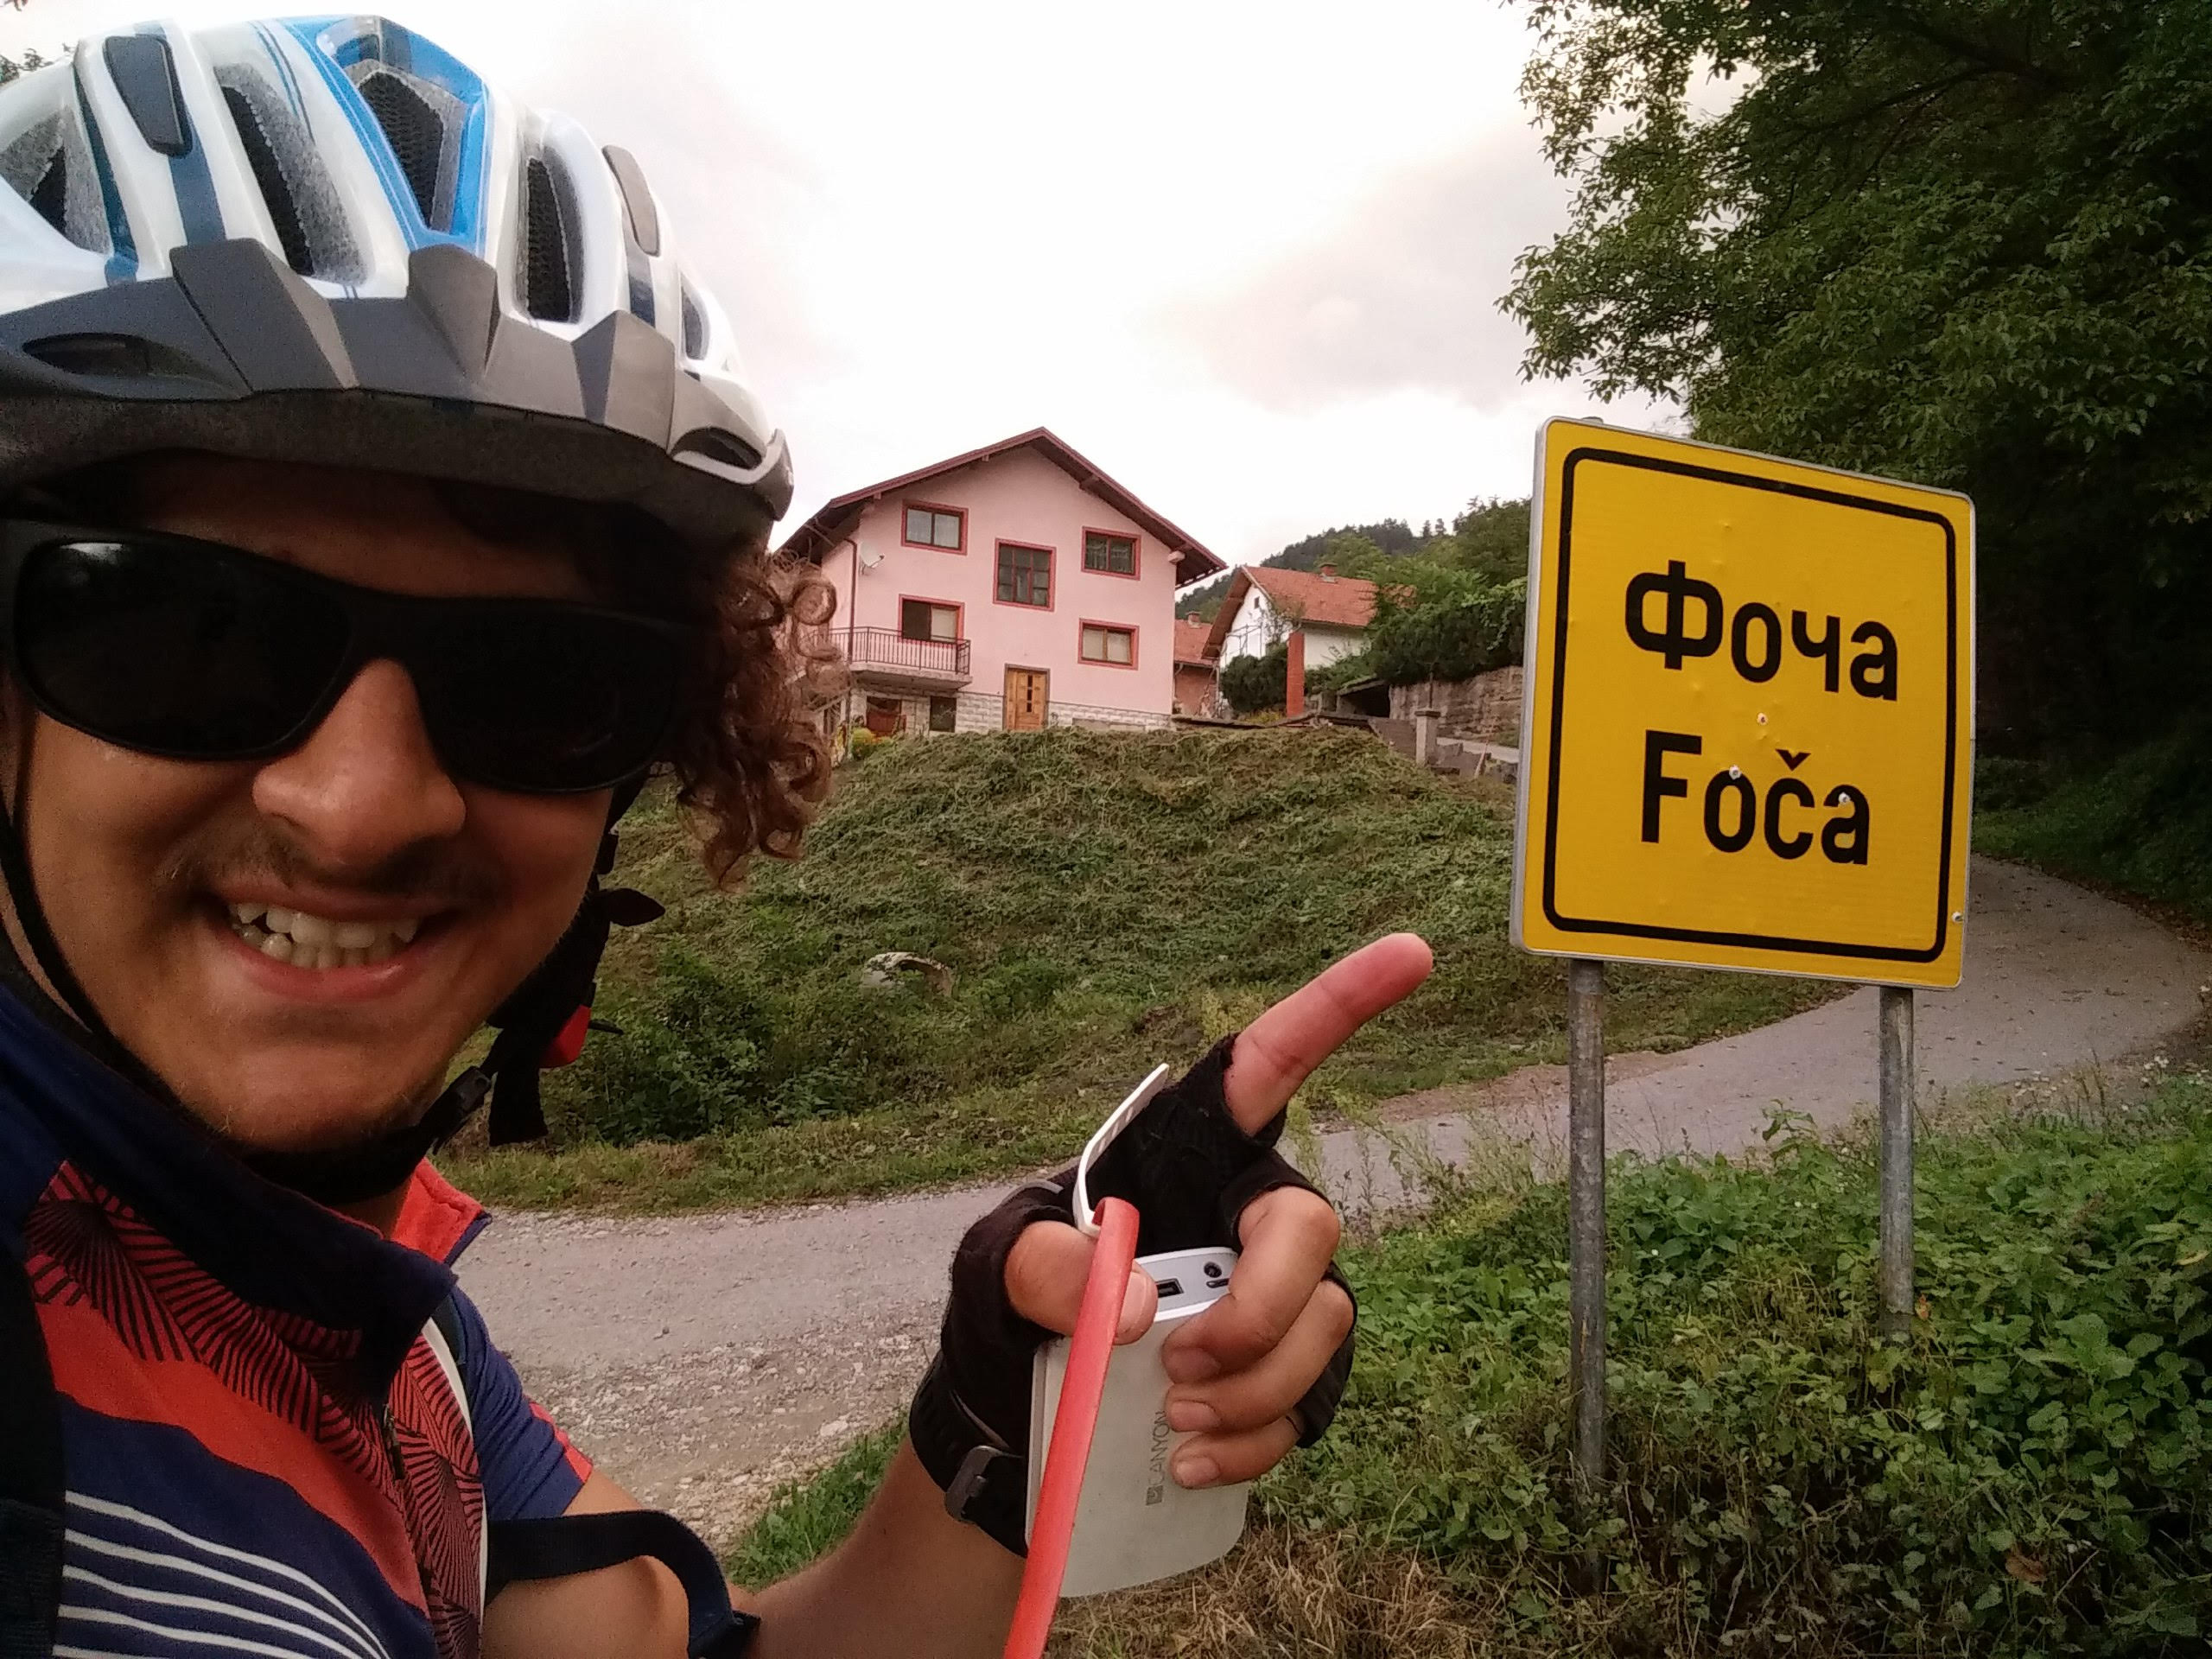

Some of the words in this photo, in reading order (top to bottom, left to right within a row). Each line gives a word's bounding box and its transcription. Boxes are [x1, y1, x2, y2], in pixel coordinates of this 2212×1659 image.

[1624, 560, 1897, 702] Фоча
[1642, 729, 1870, 866] Foča
[1147, 1410, 1170, 1486] CANYON
